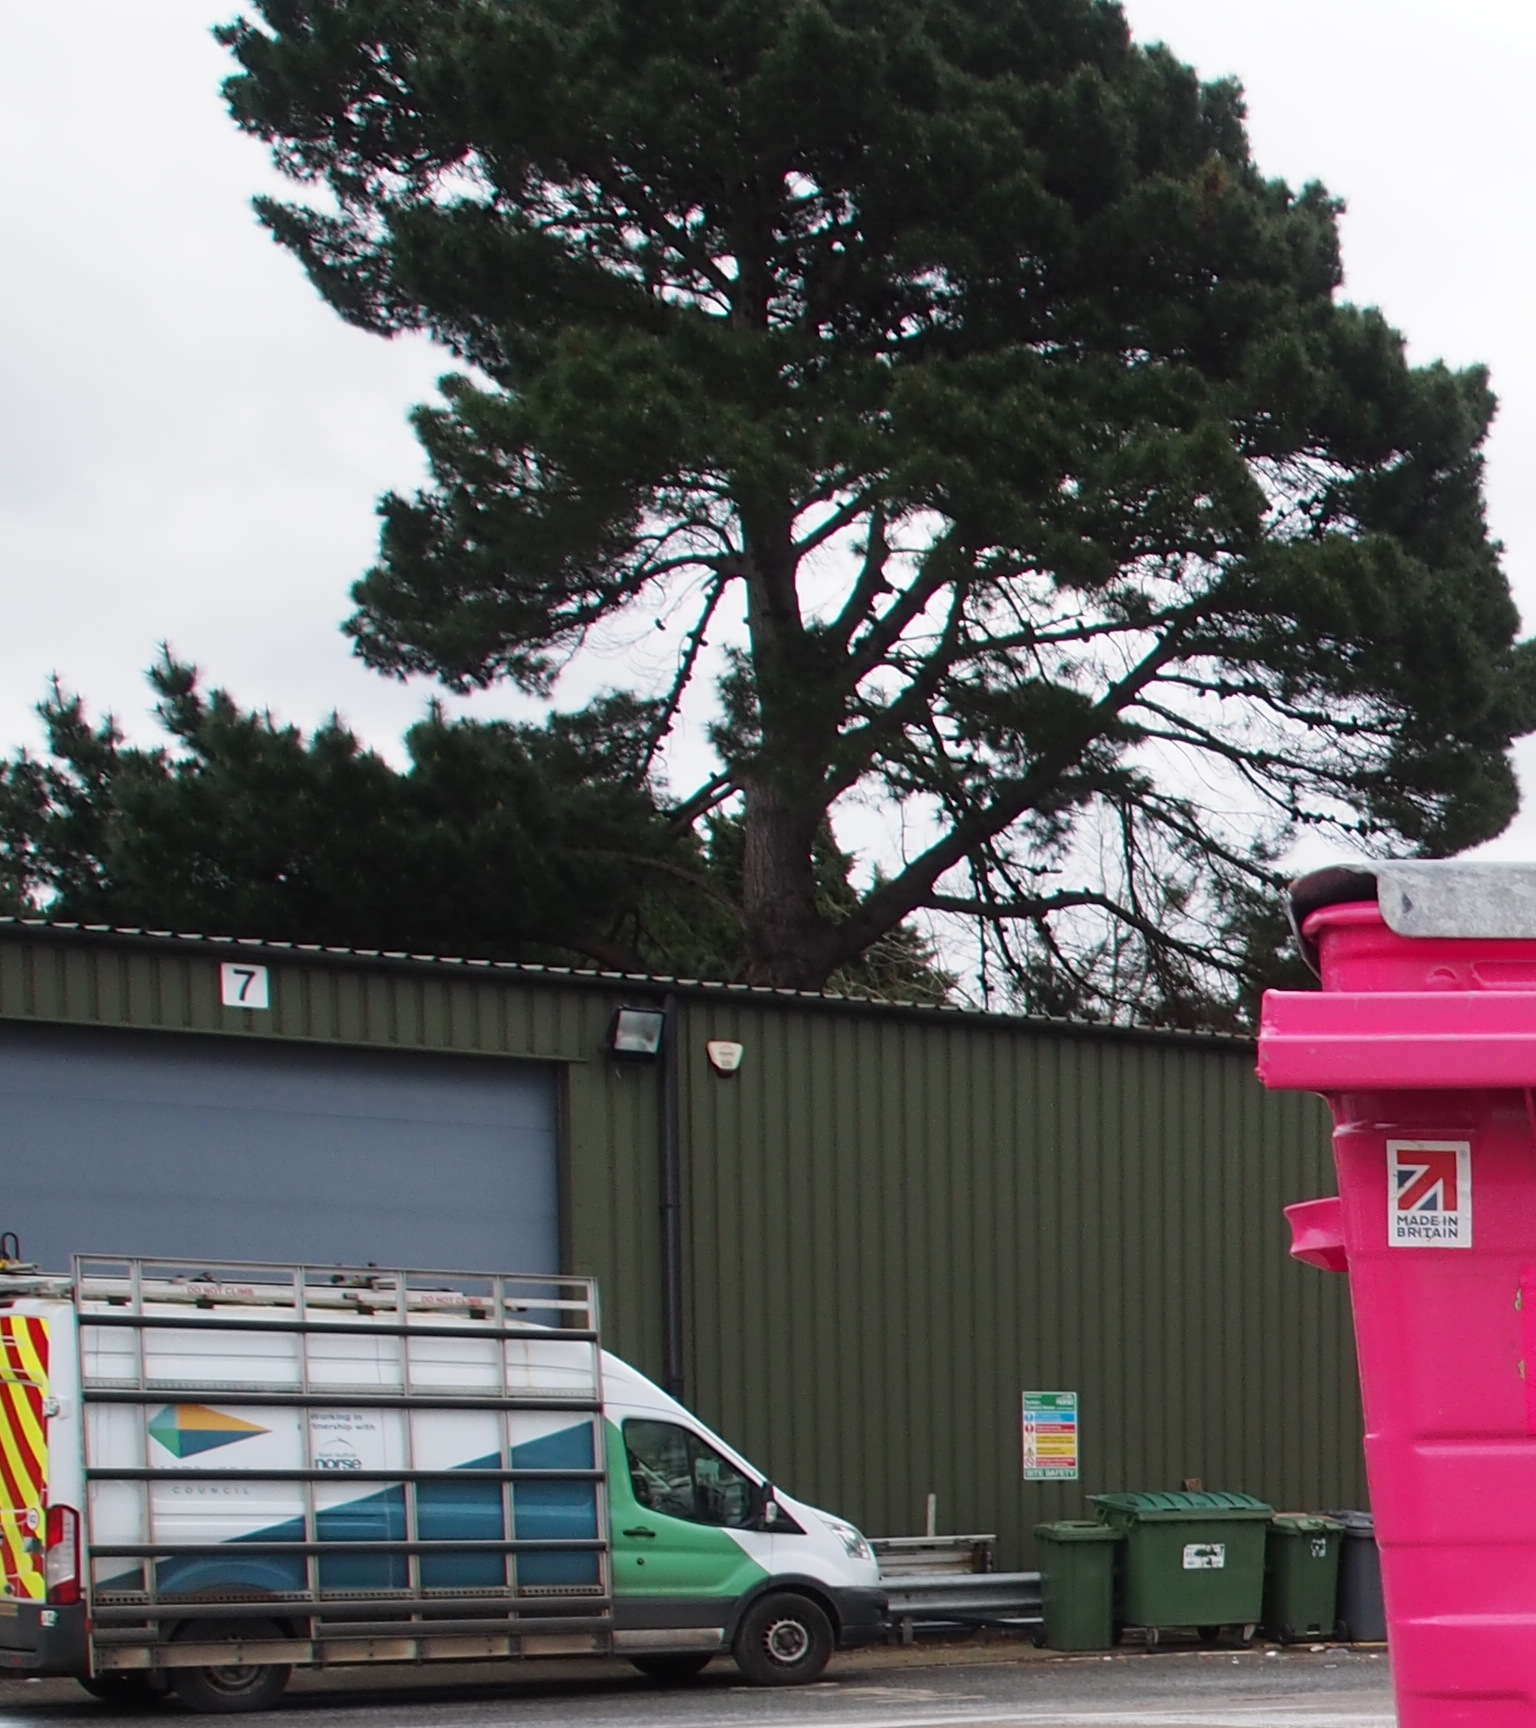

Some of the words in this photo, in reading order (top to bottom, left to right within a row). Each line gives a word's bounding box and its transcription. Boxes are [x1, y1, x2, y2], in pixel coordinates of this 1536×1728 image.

[232, 967, 256, 1002] 7
[1396, 1214, 1440, 1227] MADE
[1443, 1214, 1459, 1227] IN
[1396, 1227, 1459, 1239] BRITAIN
[314, 1458, 363, 1470] norse
[172, 1485, 249, 1496] COUNCIL
